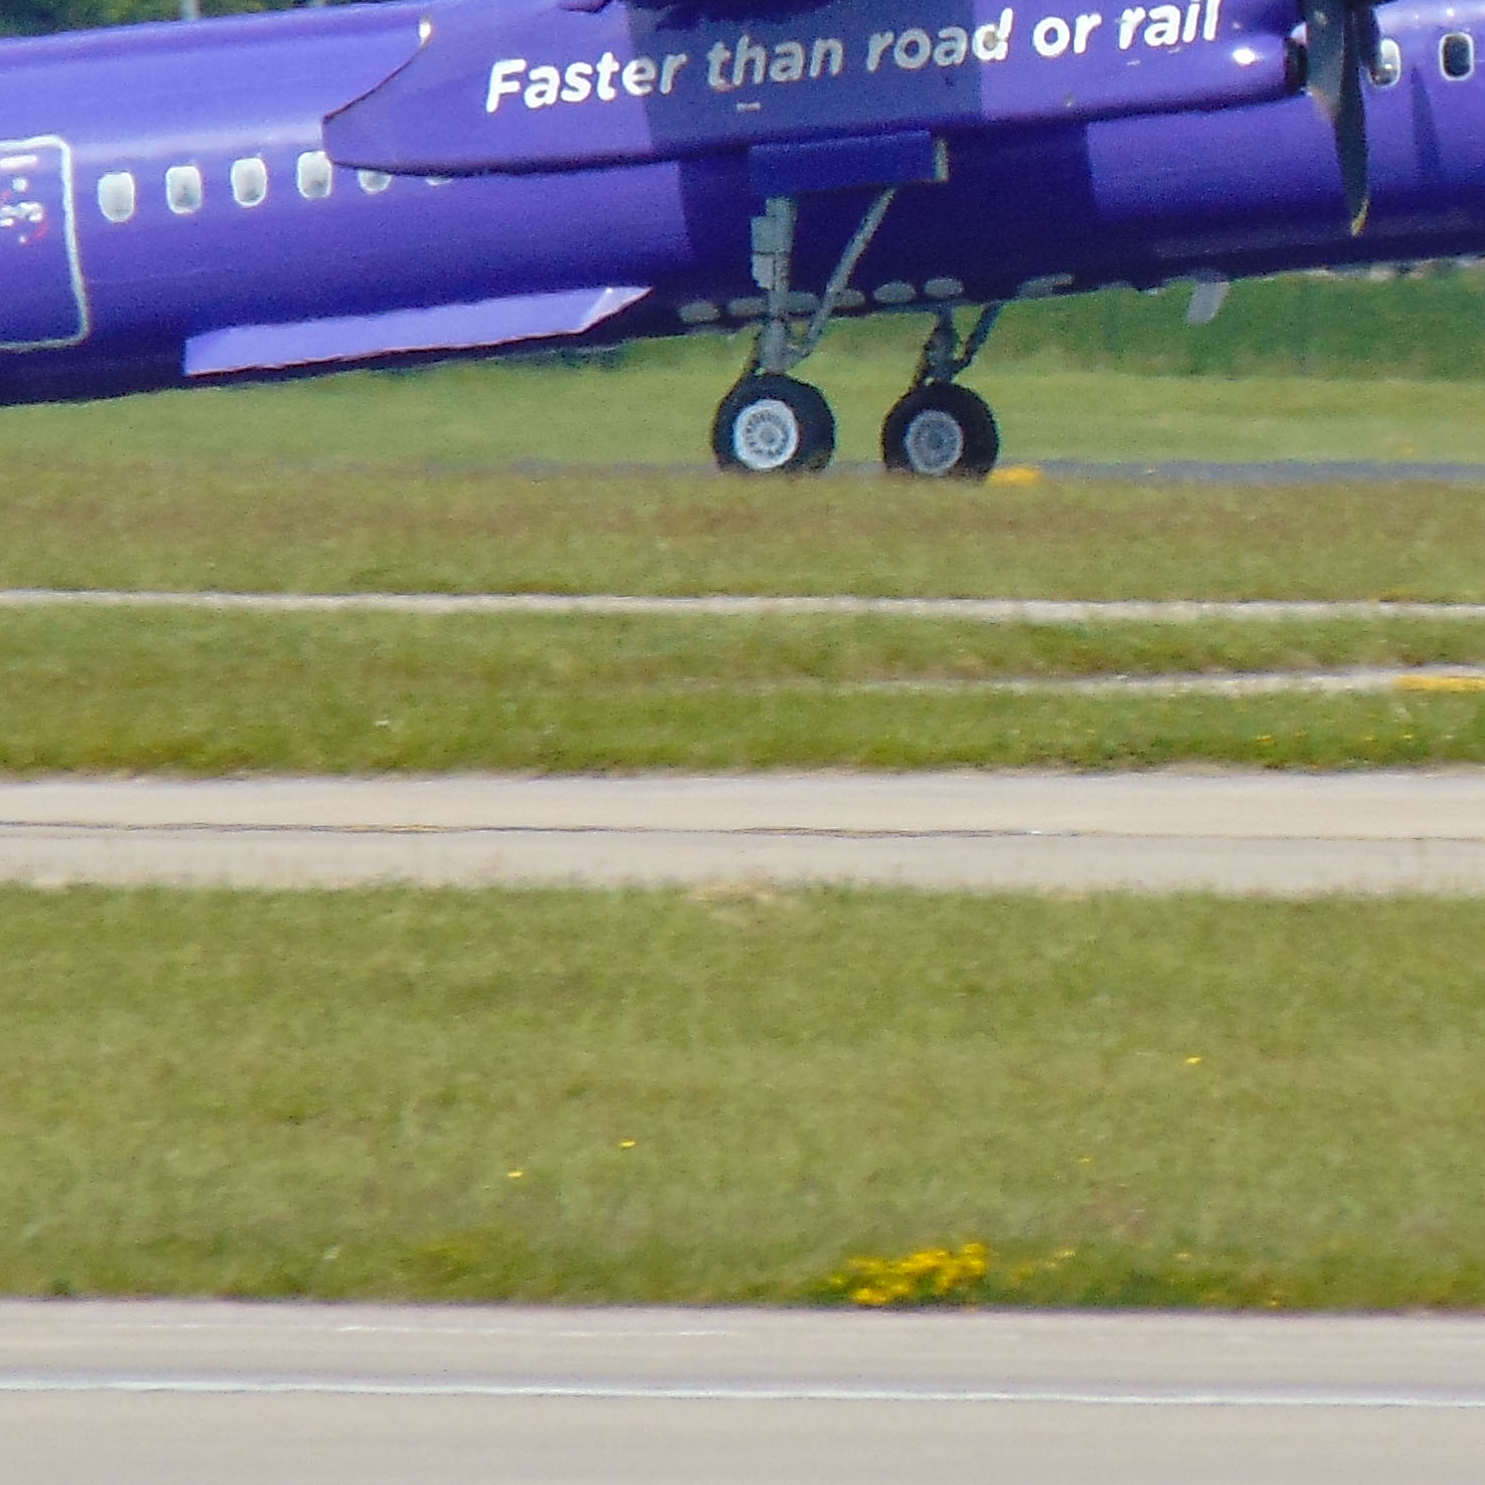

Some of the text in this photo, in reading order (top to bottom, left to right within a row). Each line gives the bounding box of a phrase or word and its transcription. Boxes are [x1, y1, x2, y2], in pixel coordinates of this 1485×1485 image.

[485, 51, 688, 113] Faster
[707, 34, 844, 90] than
[866, 7, 1014, 72] road
[1032, 13, 1102, 57] or
